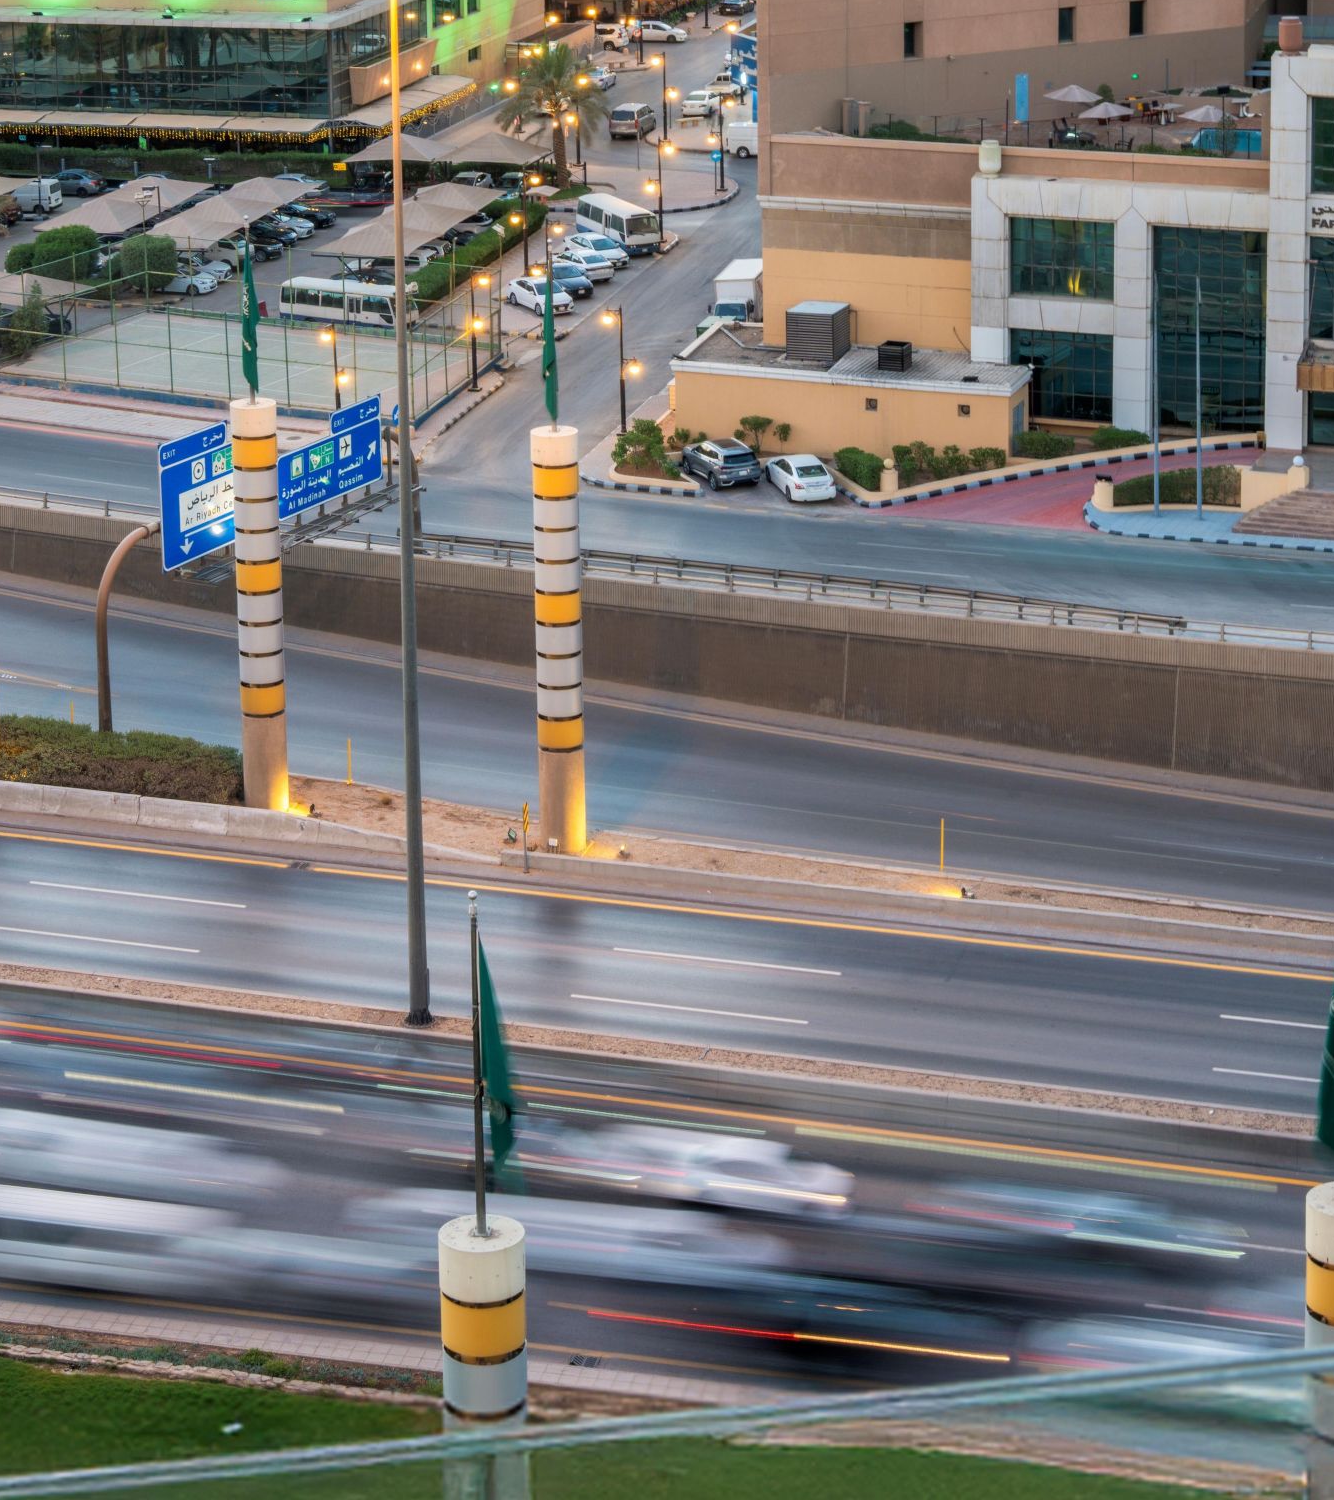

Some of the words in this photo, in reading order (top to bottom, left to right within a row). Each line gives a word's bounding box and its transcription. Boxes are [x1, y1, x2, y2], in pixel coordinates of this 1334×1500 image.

[359, 404, 377, 419] مخرج
[333, 417, 345, 428] EXIT
[202, 430, 223, 448] مخرج
[162, 448, 176, 460] EXIT
[338, 455, 364, 478] القصيم
[282, 479, 306, 500] المنورة
[338, 473, 364, 490] Qassim
[187, 483, 219, 511] الرياض
[288, 500, 296, 511] Al
[297, 489, 326, 506] Madinah
[185, 515, 193, 526] Ar
[196, 505, 221, 524] Riyadh
